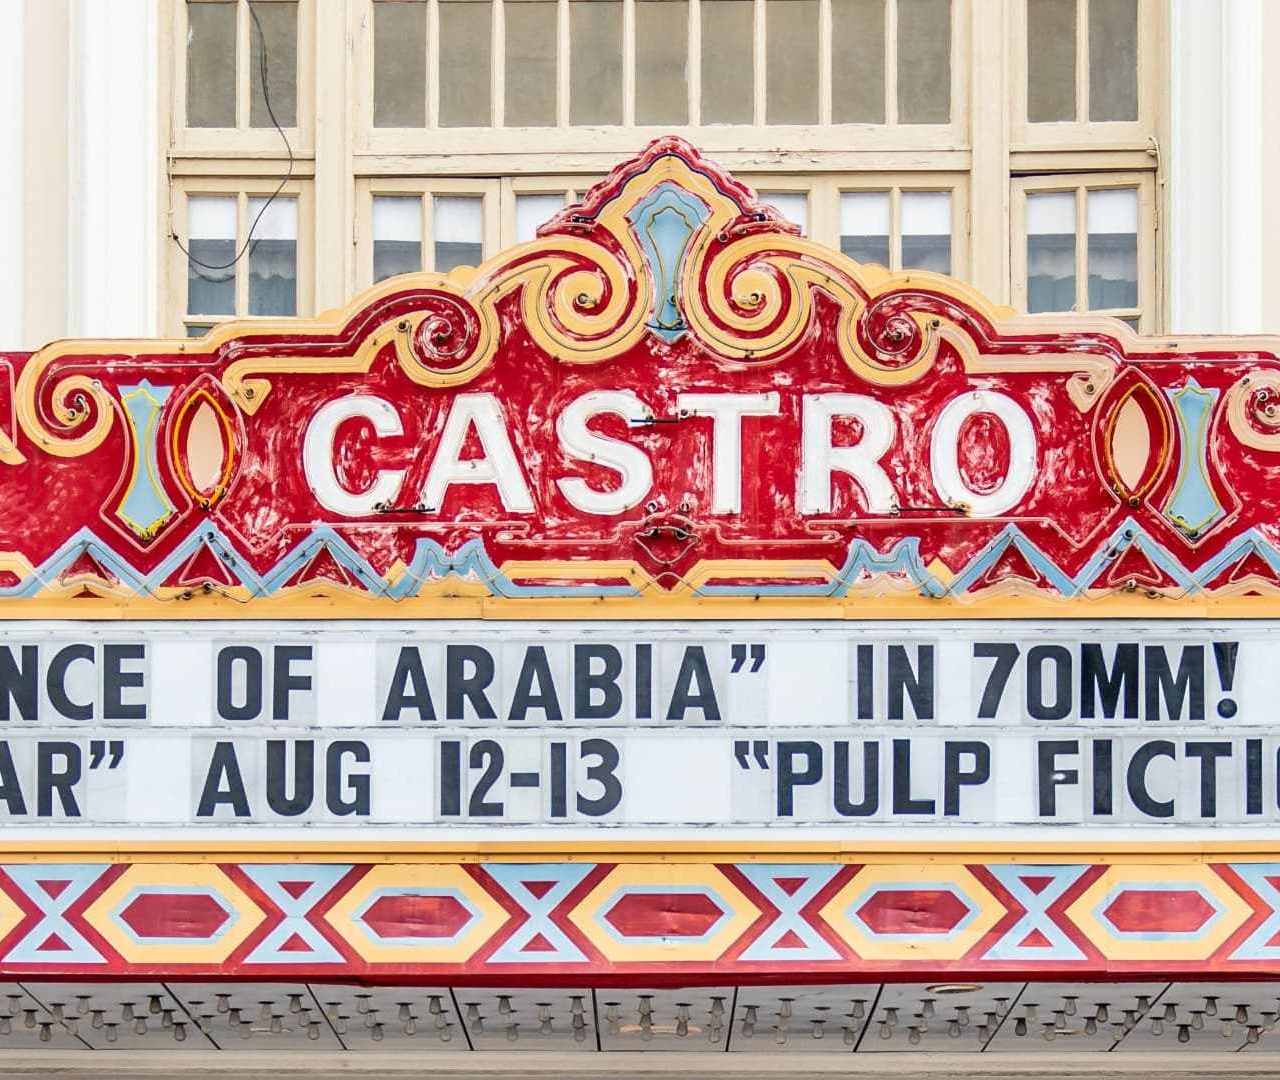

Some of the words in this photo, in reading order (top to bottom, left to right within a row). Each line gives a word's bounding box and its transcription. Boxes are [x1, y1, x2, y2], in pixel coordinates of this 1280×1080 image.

[304, 390, 1038, 517] CASTRO
[218, 646, 312, 720] OF
[382, 644, 765, 720] ARABIA"
[858, 645, 933, 720] IN
[974, 642, 1238, 721] 70MM!
[197, 740, 370, 816] AUG
[441, 739, 622, 817] 12-13
[735, 739, 990, 816] "PULP
